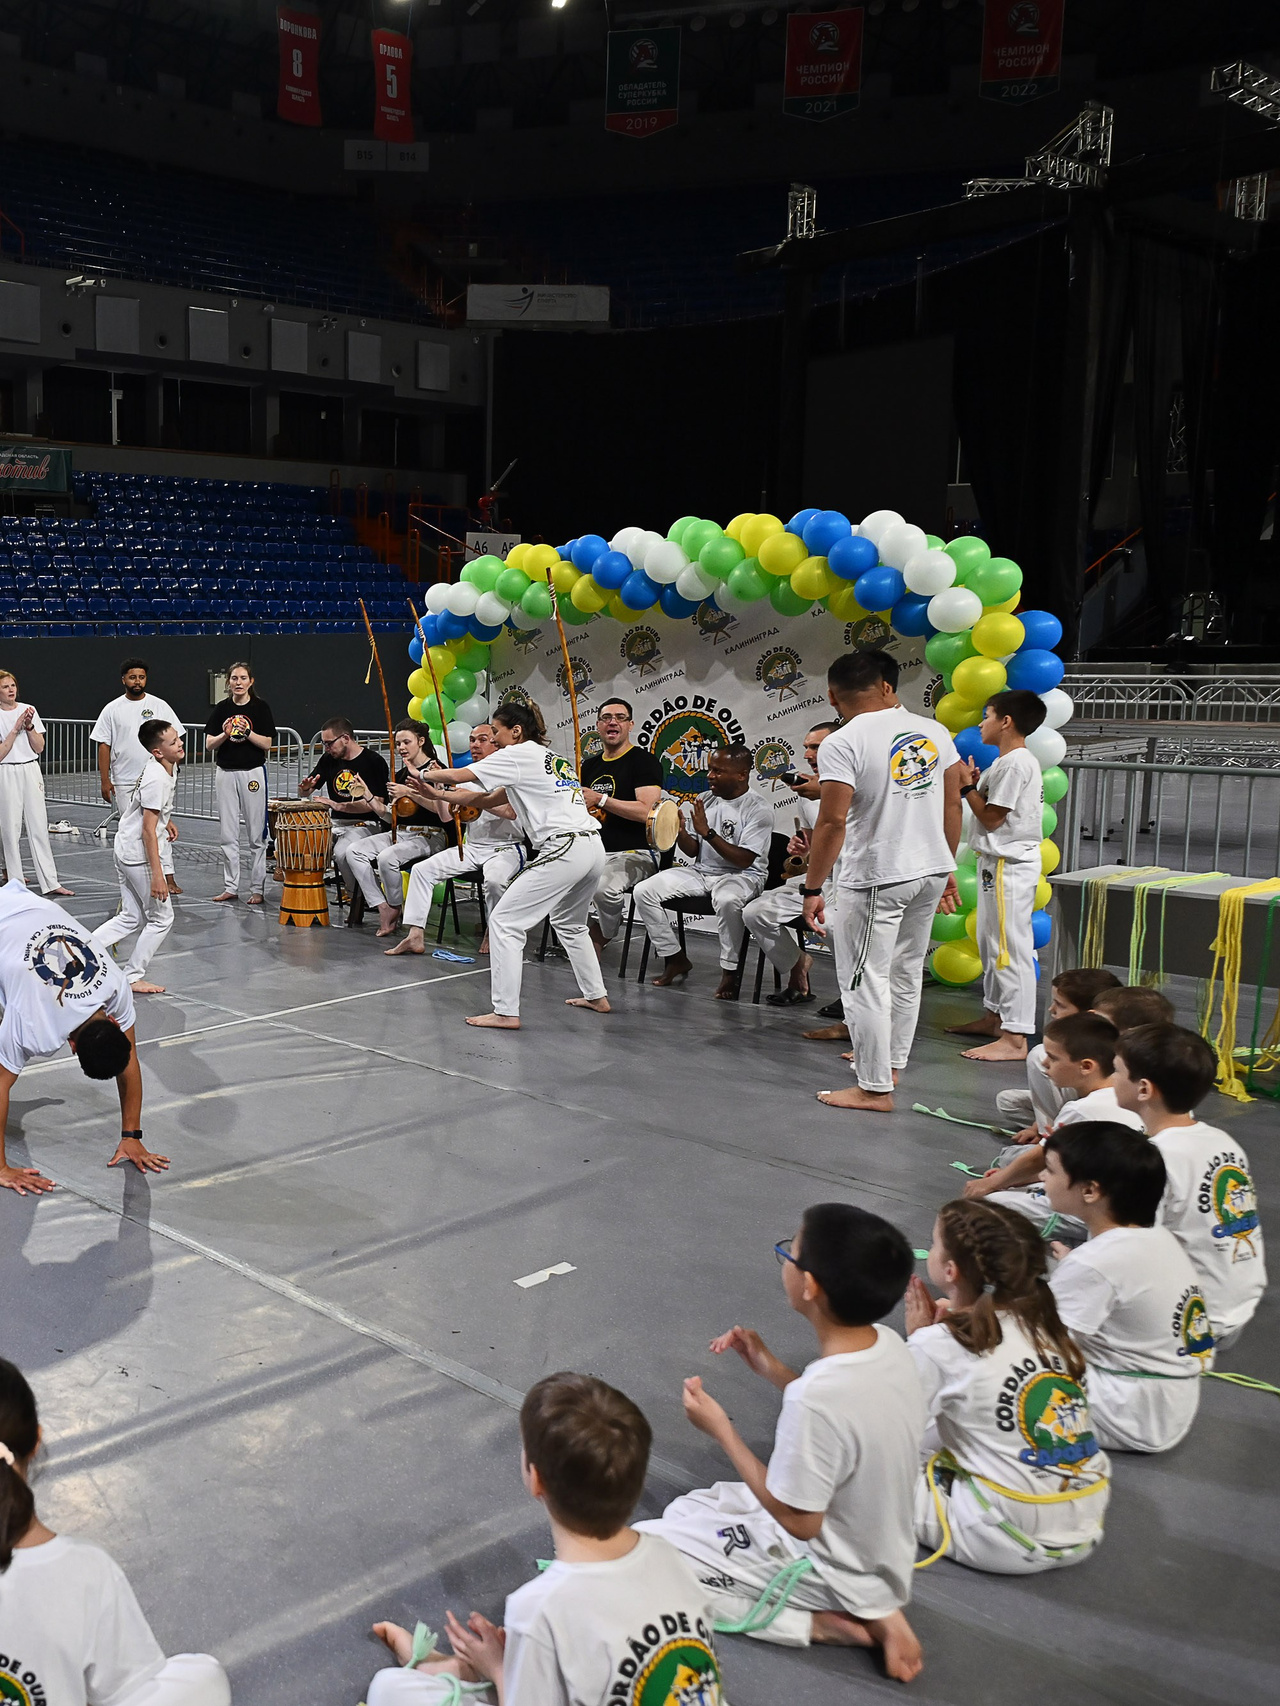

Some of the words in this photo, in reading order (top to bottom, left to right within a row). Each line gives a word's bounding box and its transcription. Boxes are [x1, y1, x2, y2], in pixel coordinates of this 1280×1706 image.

[379, 43, 403, 59] ОРЛОВА
[993, 43, 1050, 57] ЧЕМПИОН
[292, 48, 303, 78] 8
[796, 61, 850, 74] ЧЕМПИОН
[998, 55, 1044, 69] РОССИИ
[386, 64, 398, 98] 5
[618, 81, 667, 91] ОБЛАДАТЕЛЬ
[801, 73, 845, 86] РОССИИ
[618, 89, 667, 99] СУПЕРКУБКА
[1001, 83, 1038, 98] 2022
[627, 97, 658, 106] РОССИИ
[805, 100, 837, 114] 2021
[626, 116, 658, 130] 2019
[357, 150, 373, 161] B15
[472, 540, 488, 554] A6
[645, 626, 661, 642] OURO
[724, 626, 780, 656] КАЛИНИНГРАД
[545, 632, 590, 657] КАЛИИНГРАД
[785, 647, 802, 665] OURO
[555, 663, 566, 687] CORDÃ
[635, 669, 685, 695] КАЛИНИНГРАД
[766, 694, 825, 723] КАЛИНИНГРАД
[637, 695, 688, 746] ORDÃO
[692, 694, 718, 713] DE
[718, 707, 746, 746] OUR
[777, 737, 795, 757] OURO
[46, 924, 79, 935] CAPOEIRA
[93, 979, 103, 990] DE
[1221, 1152, 1236, 1164] DE
[995, 1357, 1037, 1433] CORDÃO
[606, 1622, 661, 1706] RDÃO
[659, 1611, 691, 1636] DE
